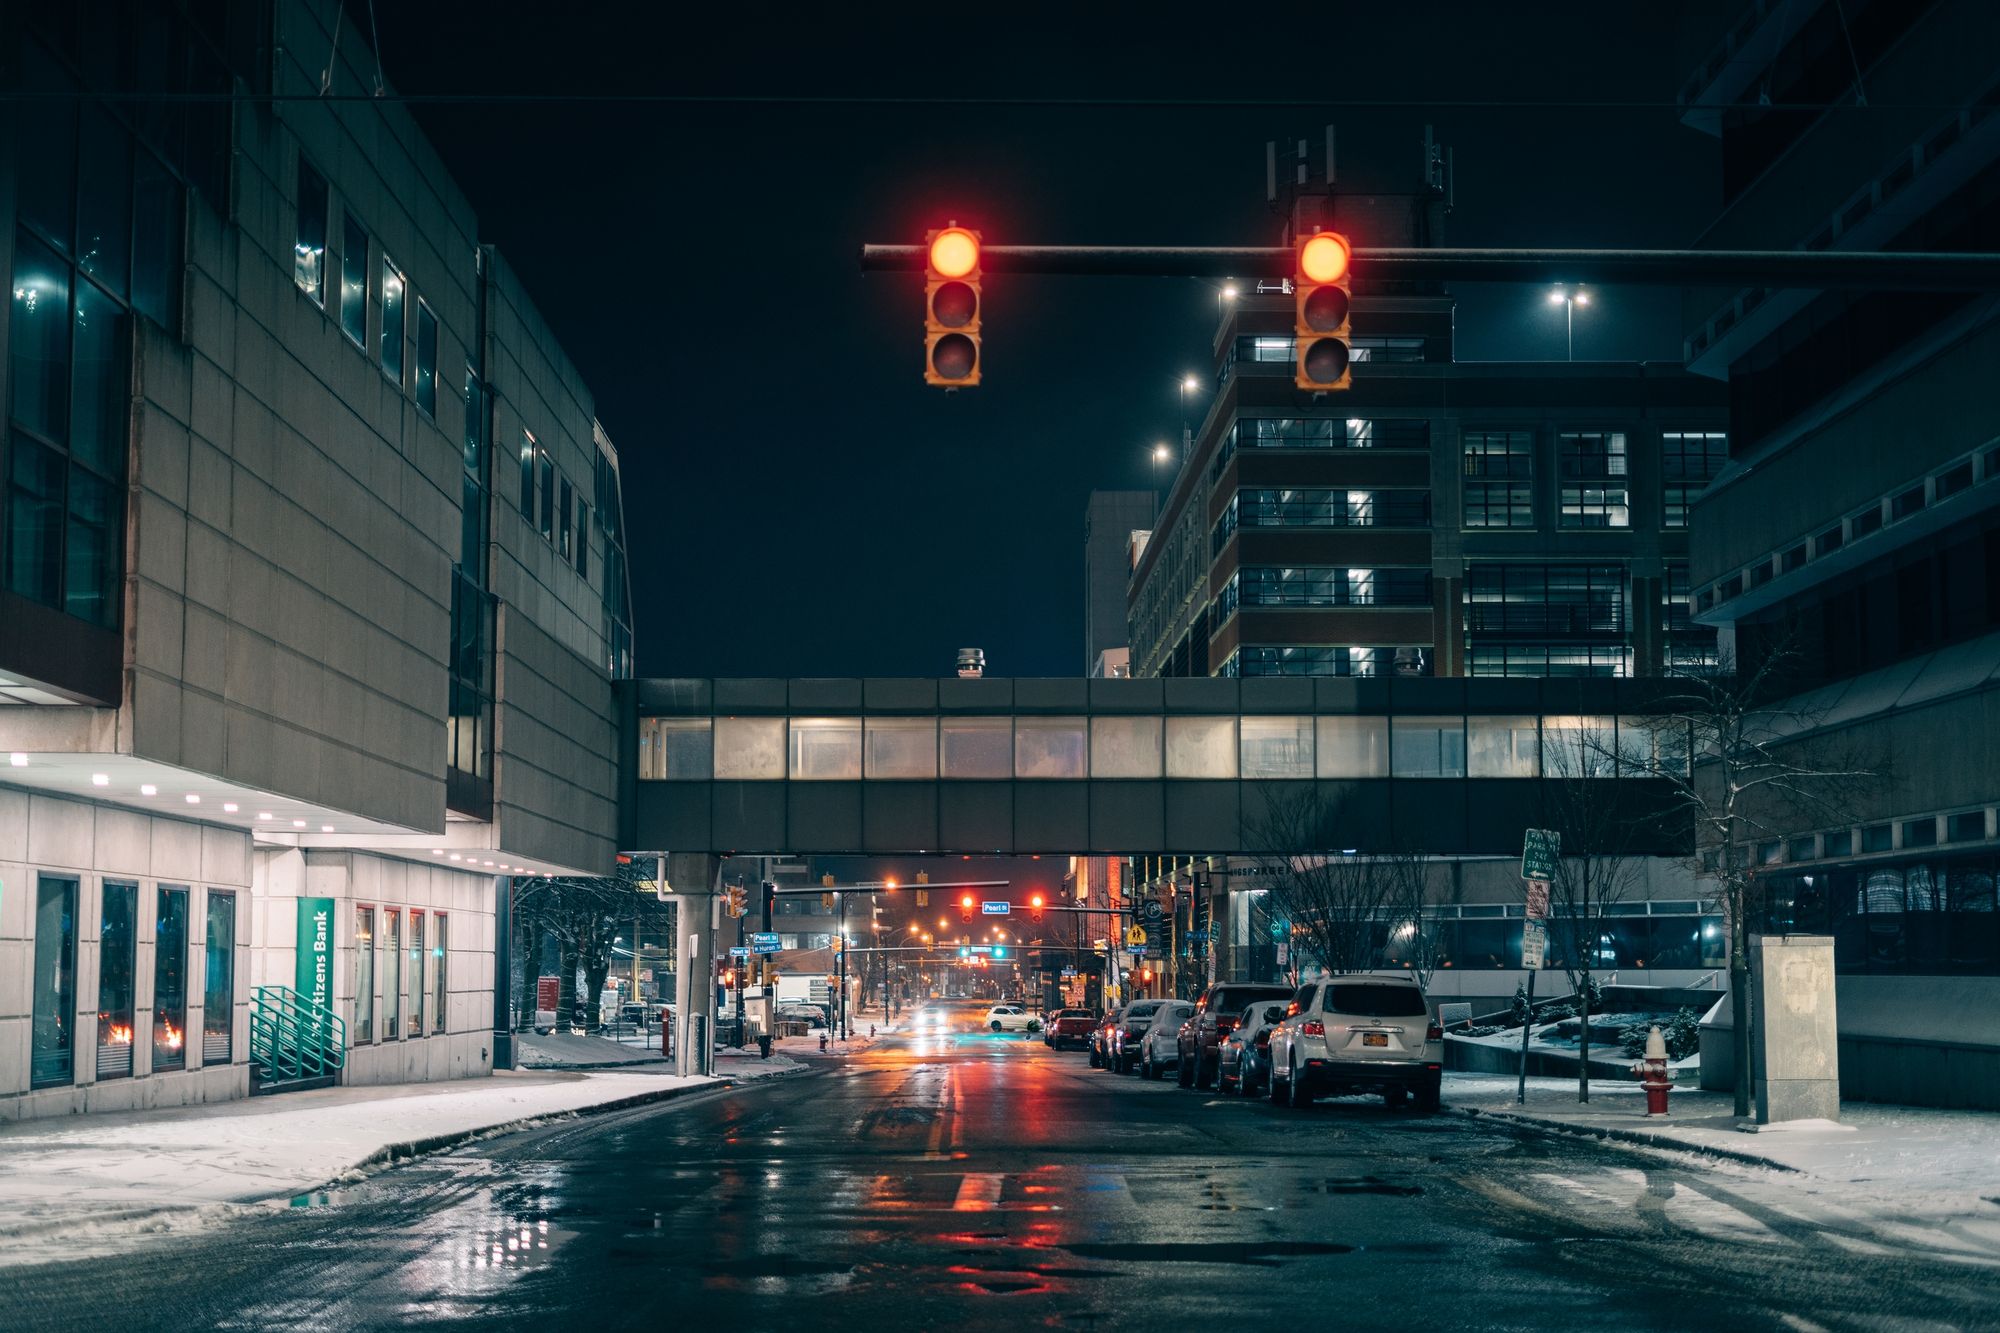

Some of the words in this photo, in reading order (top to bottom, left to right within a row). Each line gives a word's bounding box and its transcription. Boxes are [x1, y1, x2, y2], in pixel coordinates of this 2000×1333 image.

[313, 911, 327, 952] Bank
[759, 944, 776, 952] Huron
[312, 955, 326, 1023] Citizens
